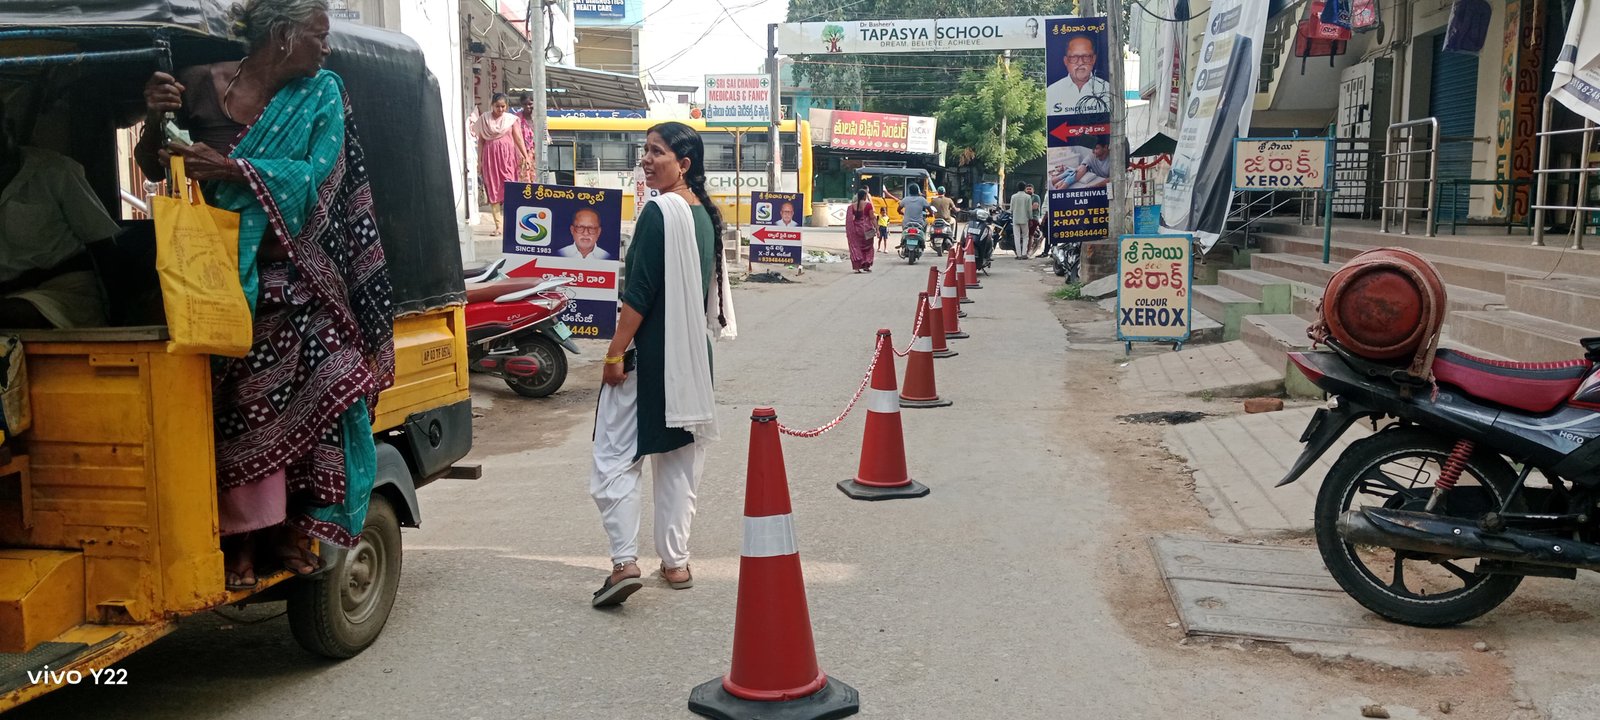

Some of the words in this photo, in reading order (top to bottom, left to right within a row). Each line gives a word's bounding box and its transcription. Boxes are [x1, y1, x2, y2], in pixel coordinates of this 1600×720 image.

[860, 27, 929, 41] TAPASYA
[936, 25, 1003, 40] SCHOOL
[716, 79, 726, 88] SRI
[727, 79, 736, 88] SAI
[738, 78, 760, 88] CHANDU
[709, 90, 741, 101] MEDICALS
[749, 90, 769, 101] FANCY
[1245, 175, 1304, 187] XEROX
[522, 184, 532, 199] శ్రీ
[535, 185, 575, 200] శ్రీనివాస
[577, 190, 605, 205] ల్యాబ్
[1053, 209, 1085, 218] BLOOD
[1053, 218, 1080, 227] X-RAY
[1083, 217, 1090, 225] &
[1060, 228, 1108, 238] 9394844449
[515, 245, 536, 253] SINCE
[536, 246, 552, 254] 1983
[1125, 241, 1139, 264] శ్రీ
[1142, 243, 1183, 260] సాయి
[586, 275, 605, 284] దారి
[1124, 262, 1186, 297] జిరాక్స్
[1135, 298, 1168, 306] COLOUR
[1121, 308, 1185, 326] XEROX
[1559, 430, 1584, 444] Hero
